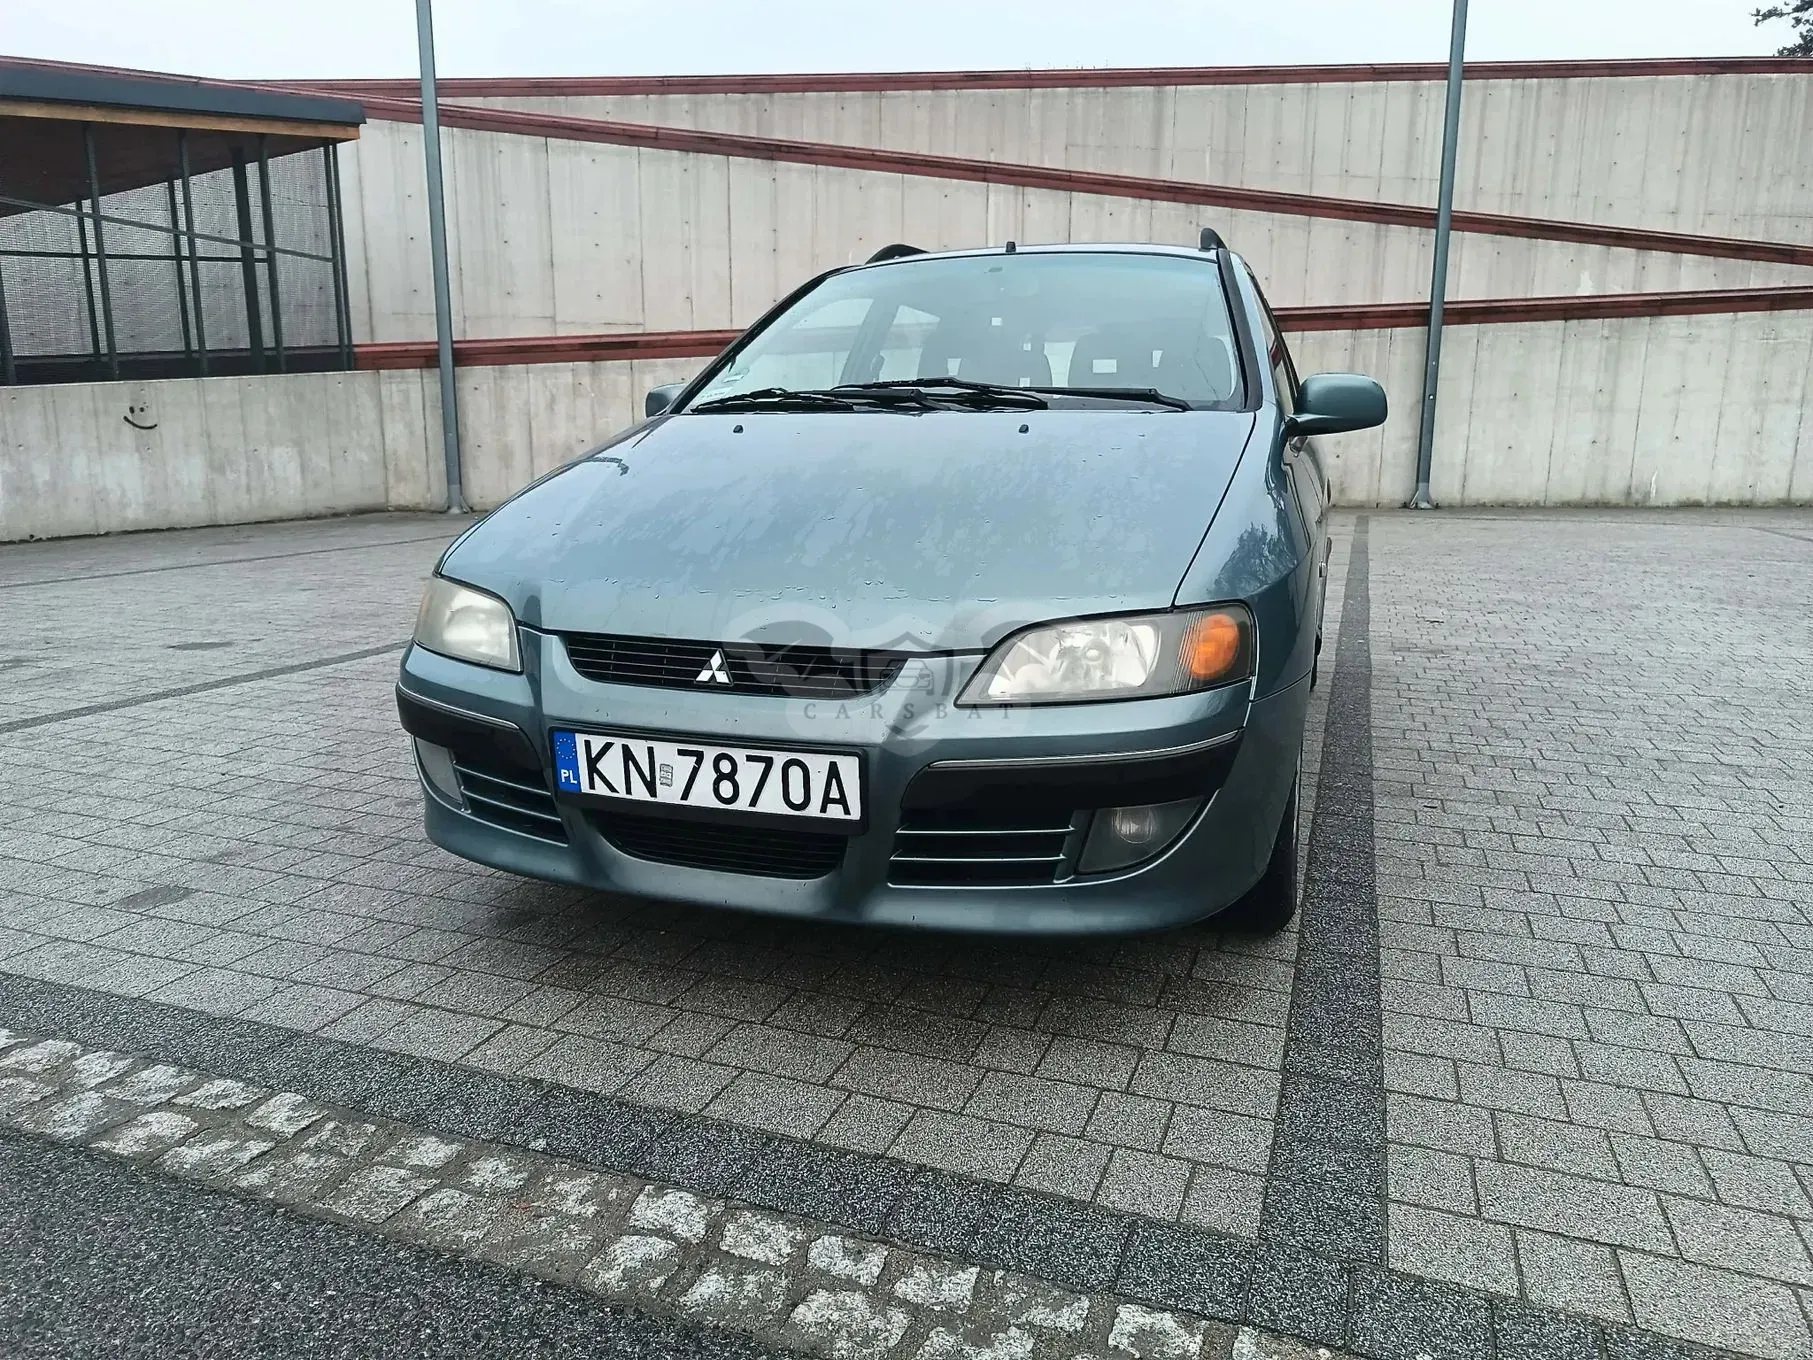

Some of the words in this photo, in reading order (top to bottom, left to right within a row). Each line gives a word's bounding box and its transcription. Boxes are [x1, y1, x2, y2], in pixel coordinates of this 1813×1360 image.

[560, 768, 578, 785] PL
[583, 738, 658, 798] KN
[676, 748, 852, 816] 7870A
